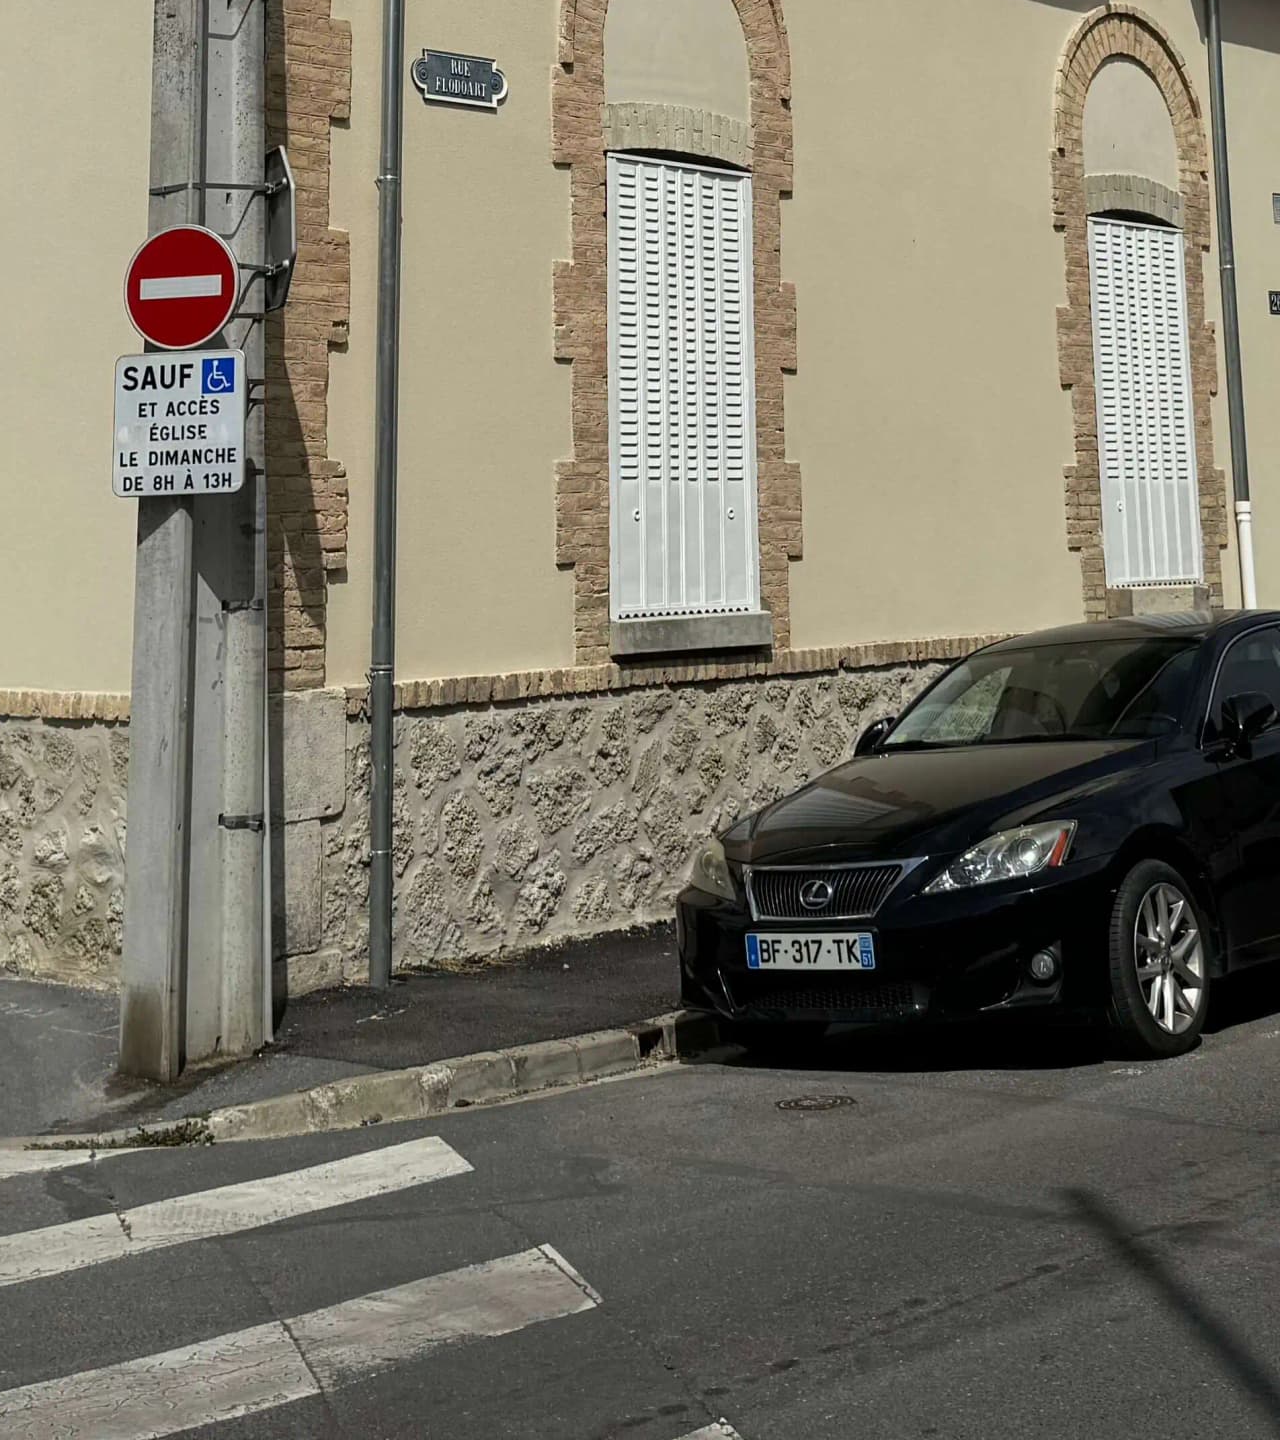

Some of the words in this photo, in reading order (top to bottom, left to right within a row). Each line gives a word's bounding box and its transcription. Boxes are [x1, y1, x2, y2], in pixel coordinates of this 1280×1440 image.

[451, 58, 471, 77] RUE
[435, 76, 486, 97] FLODOART
[122, 364, 194, 392] SAUF
[138, 403, 158, 418] ET
[165, 396, 221, 417] ACCÈS
[149, 423, 208, 442] ÉGLISE
[119, 451, 139, 468] LE
[148, 447, 237, 467] DIMANCHE
[123, 476, 144, 492] DE
[153, 474, 174, 491] 8H
[183, 469, 194, 490] À
[203, 472, 232, 489] 13H
